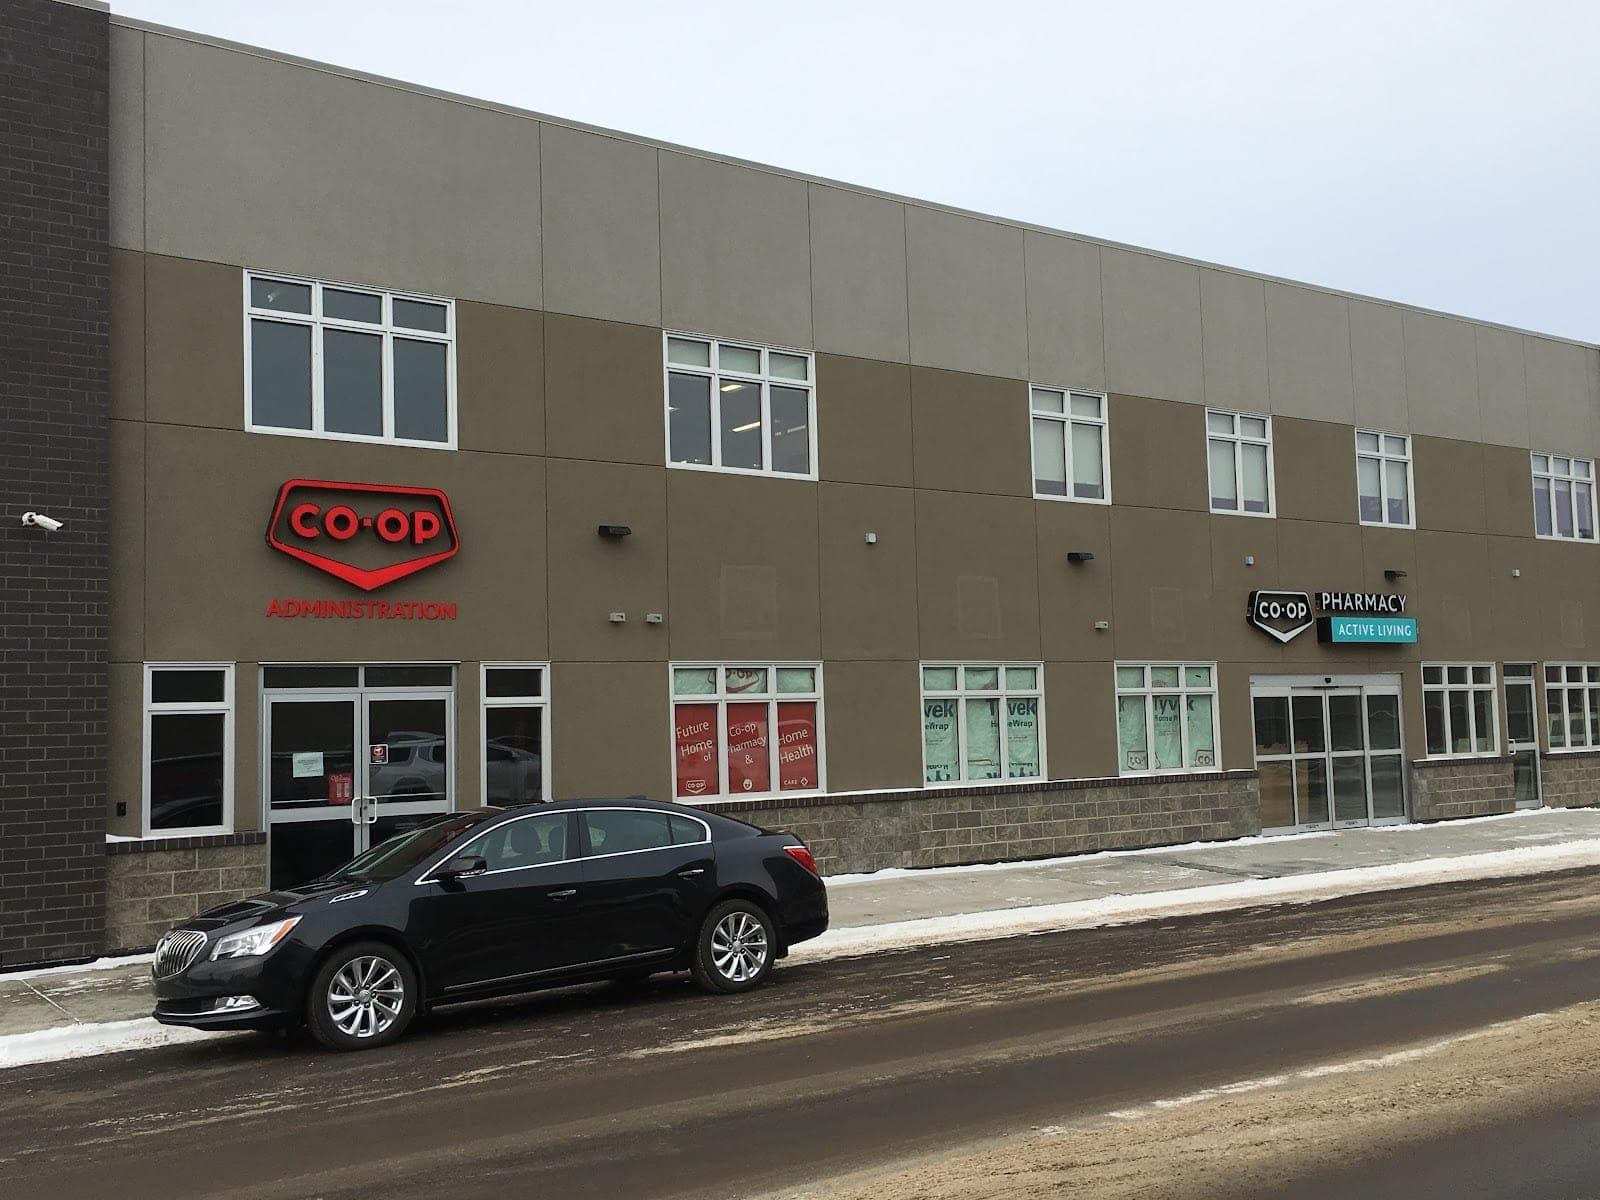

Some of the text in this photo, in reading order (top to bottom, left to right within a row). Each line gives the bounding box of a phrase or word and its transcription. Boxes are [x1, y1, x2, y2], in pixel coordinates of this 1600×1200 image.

[264, 598, 457, 620] ADMINISTRATION
[1321, 592, 1408, 613] PHARMACY
[1338, 623, 1412, 637] ACTIVE LIVING
[676, 721, 710, 739] Future
[729, 723, 757, 737] Co-op
[778, 728, 809, 745] Home
[680, 739, 713, 757] Home
[727, 735, 767, 754] harmacy
[703, 752, 712, 761] of
[745, 754, 754, 765] &
[780, 744, 814, 764] Health
